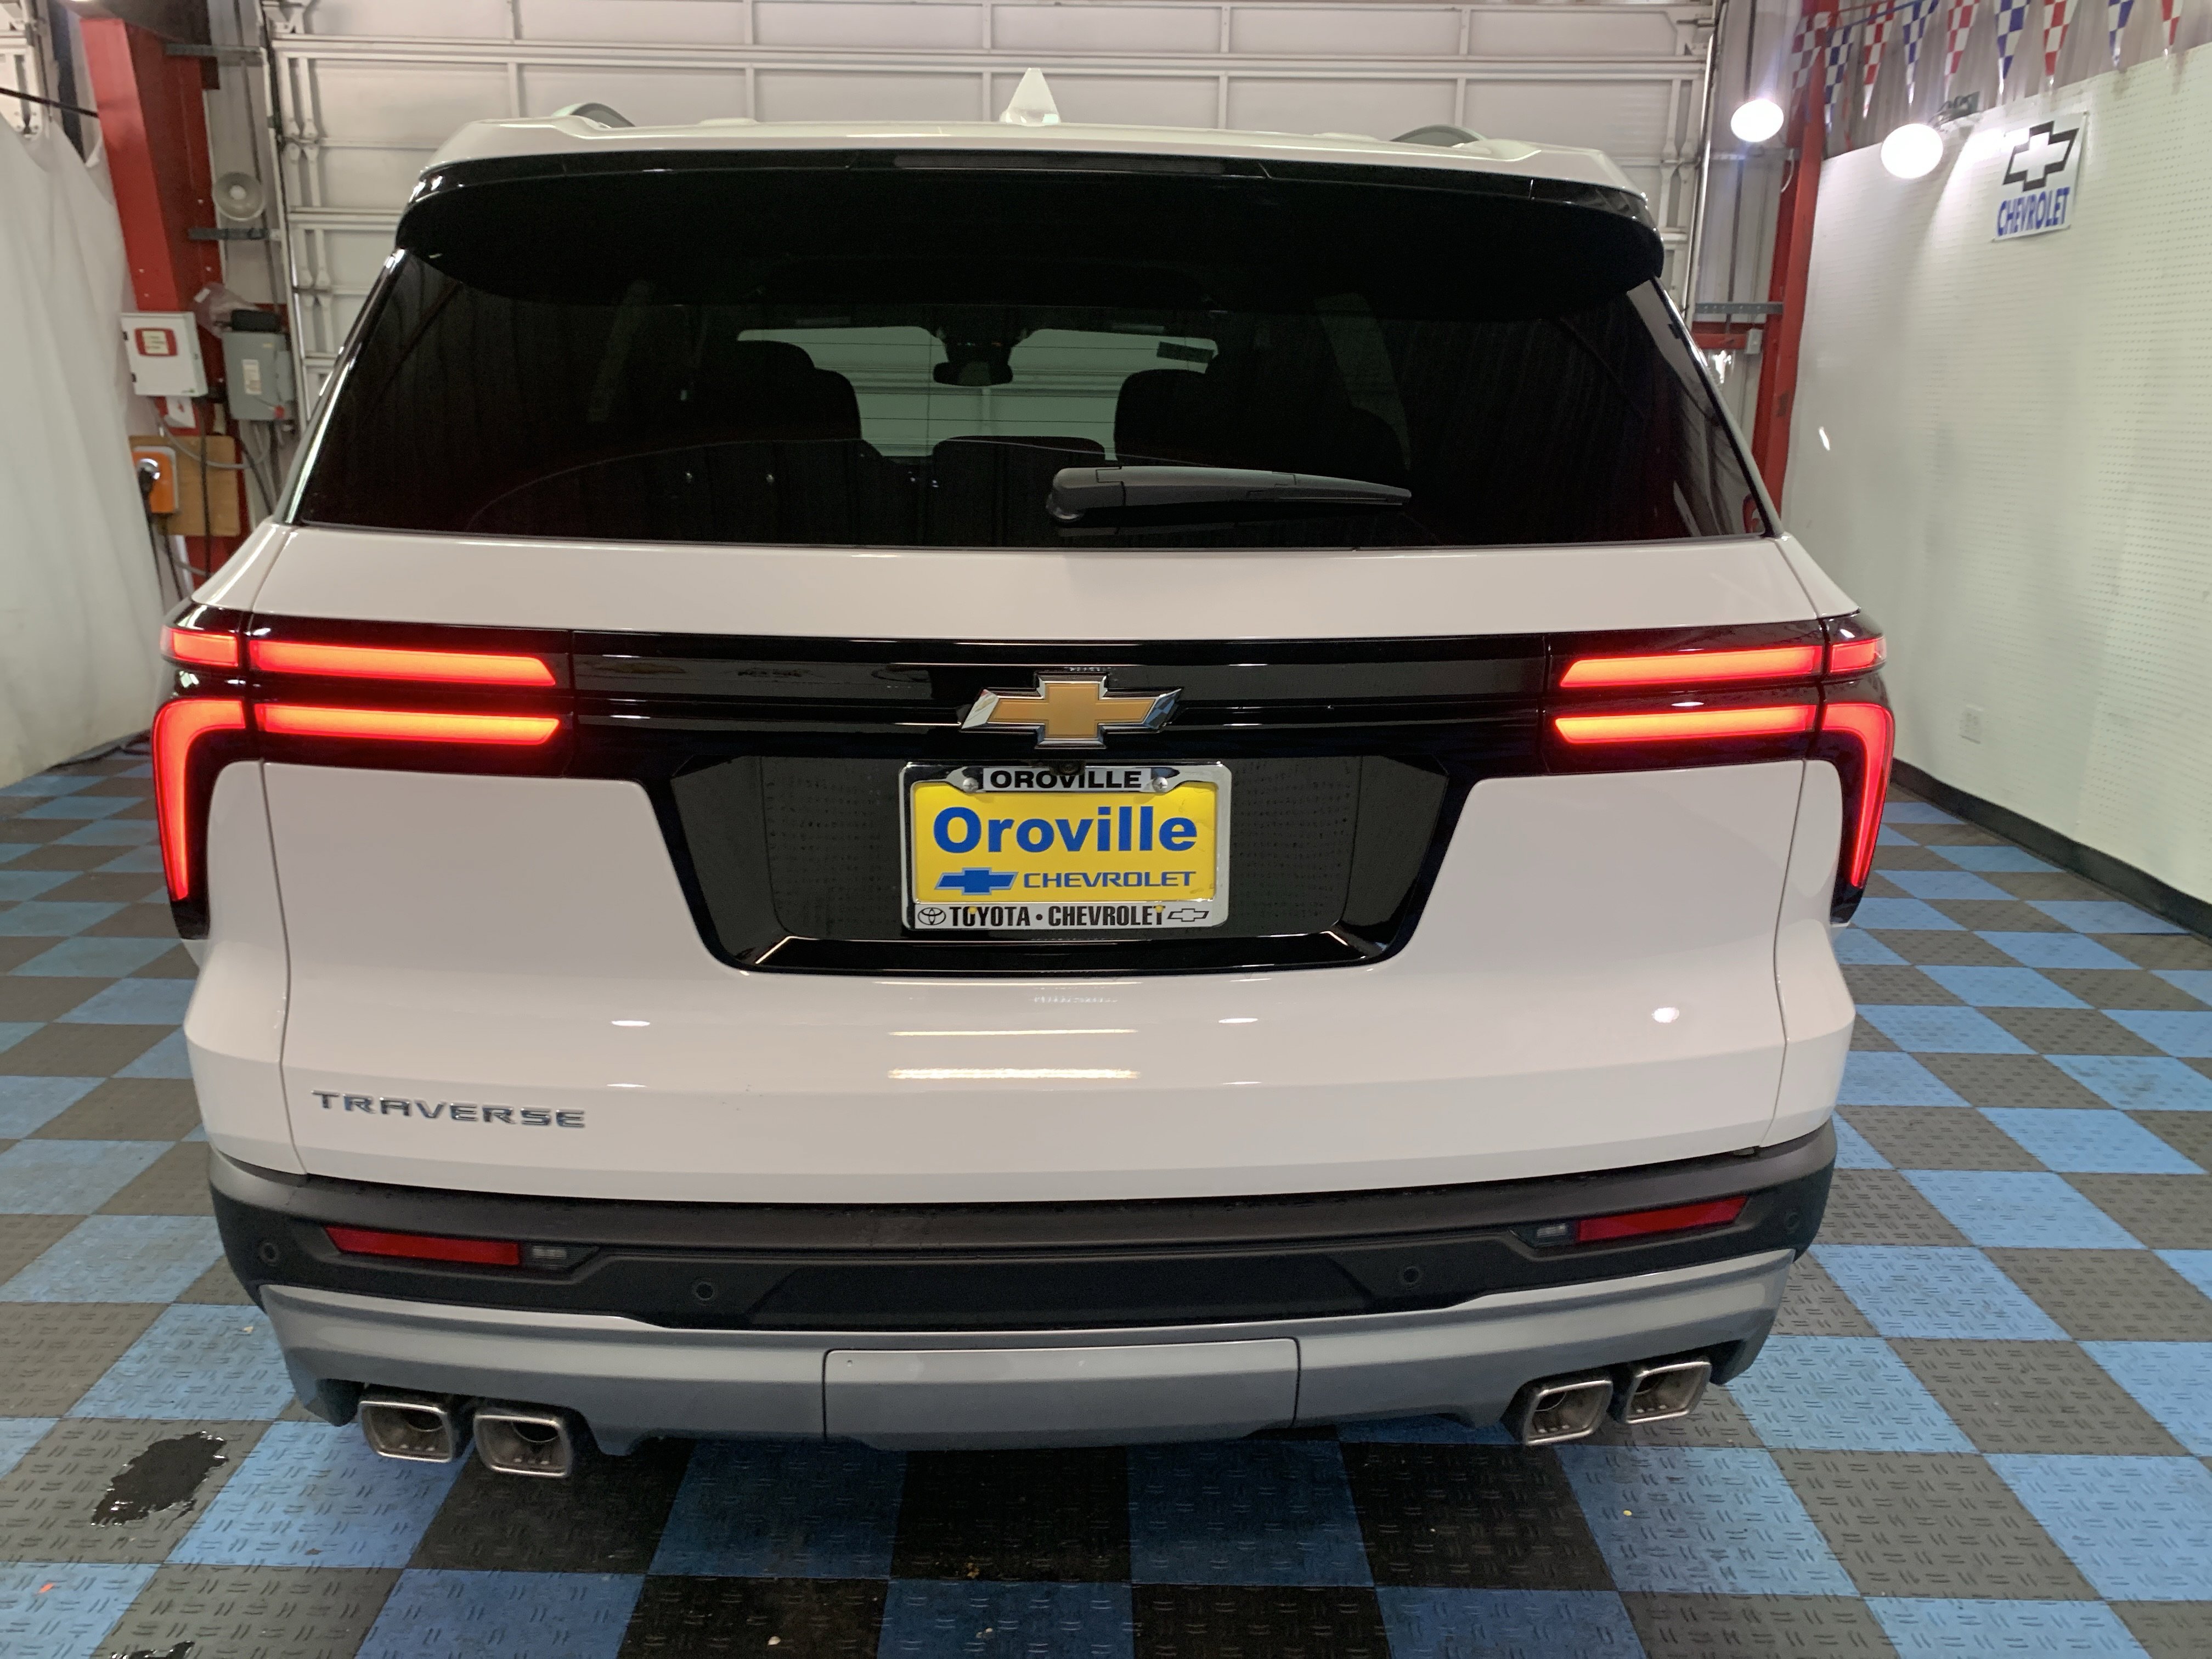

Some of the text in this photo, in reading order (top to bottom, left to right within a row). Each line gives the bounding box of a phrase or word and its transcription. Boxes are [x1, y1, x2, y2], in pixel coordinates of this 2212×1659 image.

[1997, 187, 2070, 236] CHEVROLET
[990, 771, 1142, 788] OROVILLE
[934, 806, 1197, 854] Oroville
[1024, 871, 1196, 888] CHEVROLET
[950, 906, 1166, 927] TOYOTA CHEVROLET
[311, 1090, 585, 1128] TRAVERSE
